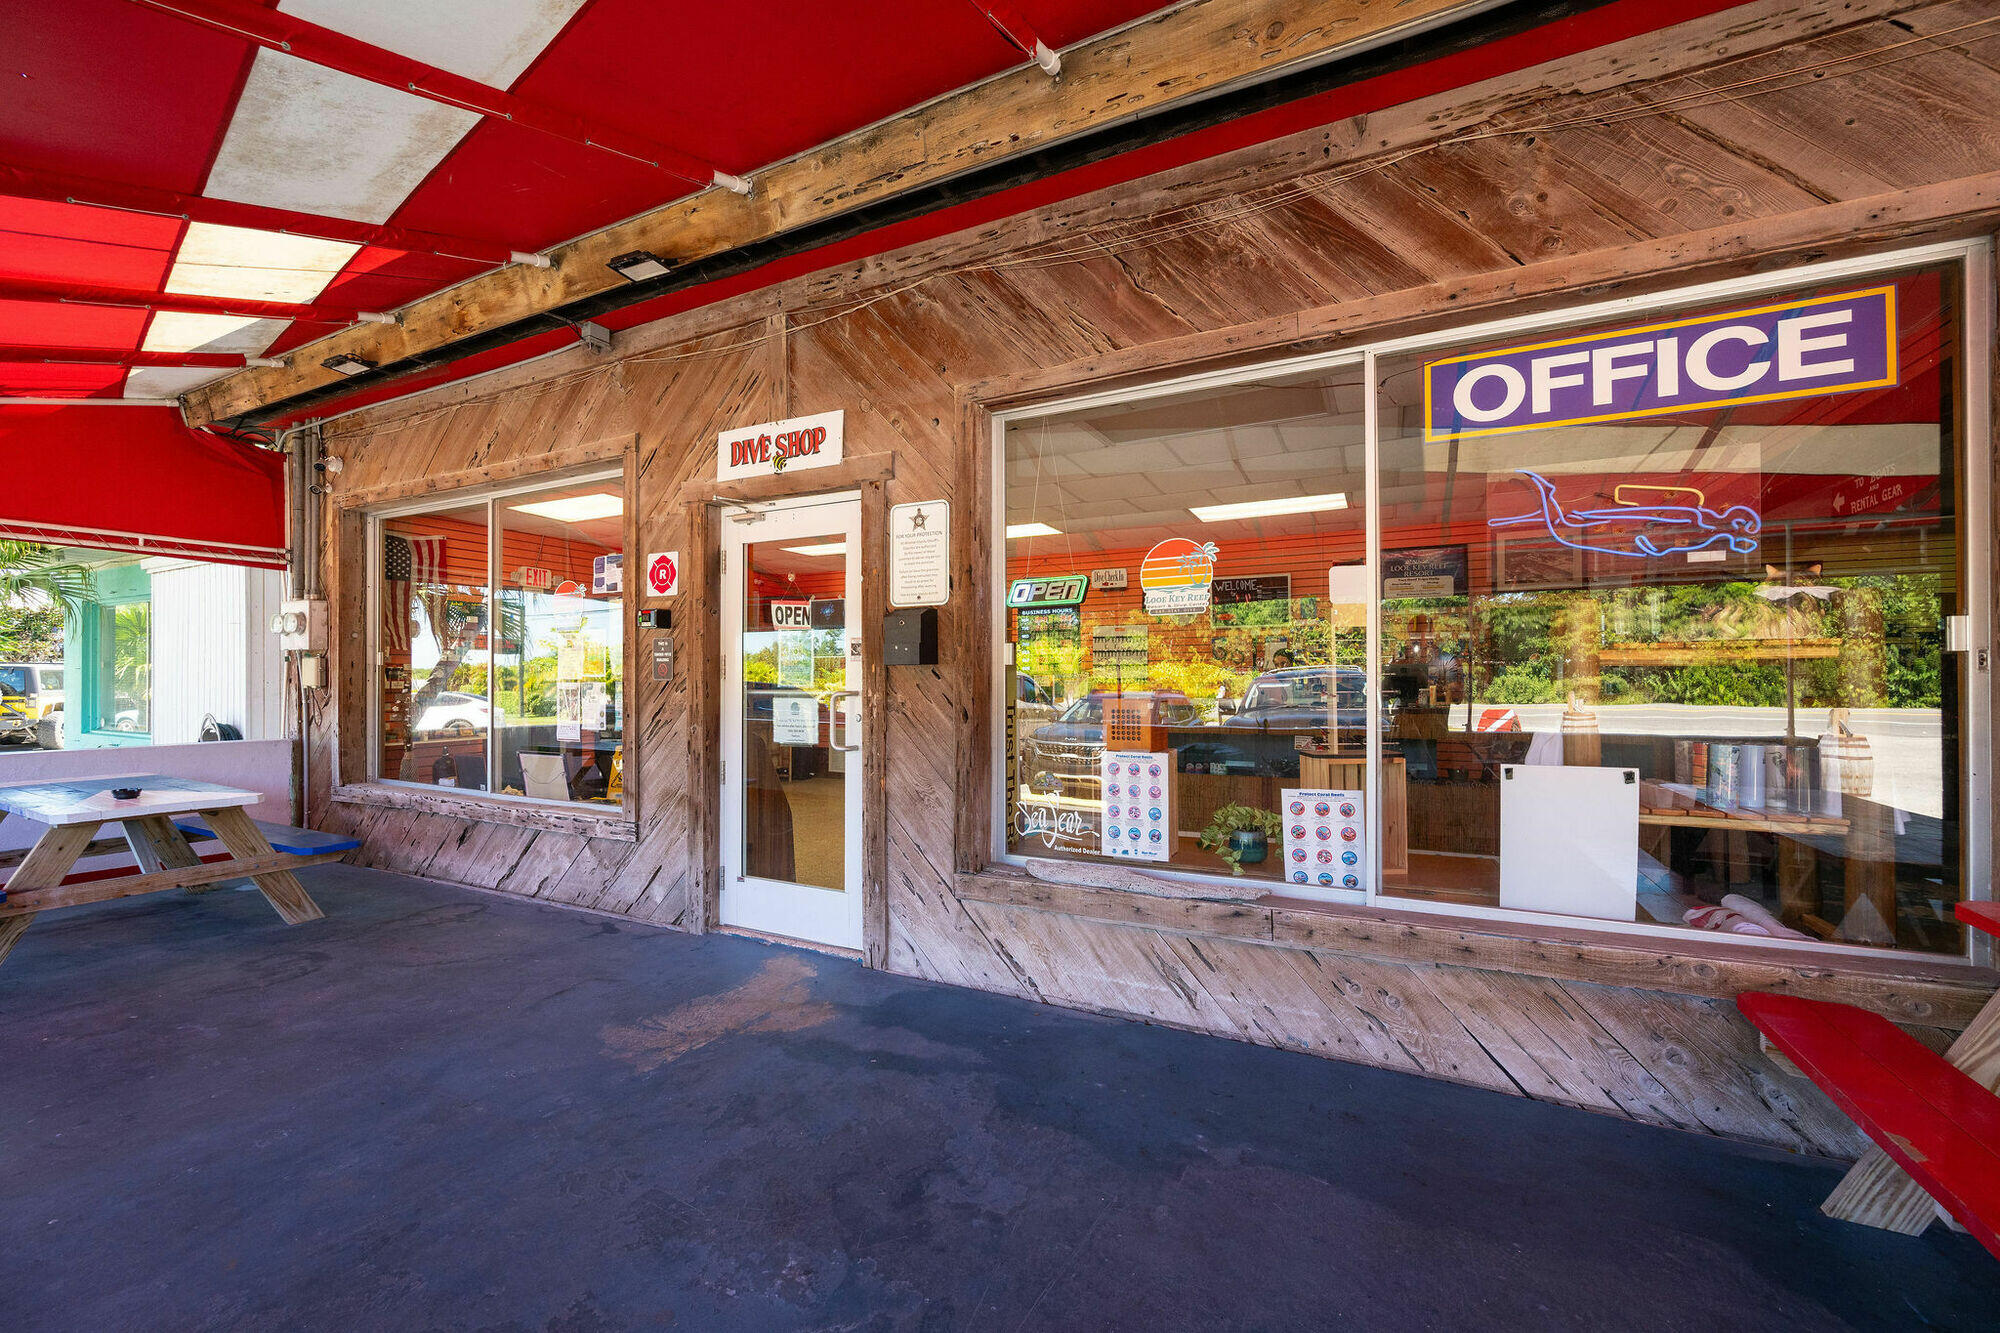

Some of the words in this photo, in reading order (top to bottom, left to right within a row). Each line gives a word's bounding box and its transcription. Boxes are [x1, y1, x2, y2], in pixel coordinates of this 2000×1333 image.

[1453, 309, 1854, 422] OFFICE
[730, 434, 772, 467] DIVE
[775, 426, 826, 460] SHOP
[1854, 477, 1864, 489] TO
[1869, 464, 1896, 484] BOATS
[1850, 494, 1879, 514] RENTAL
[1881, 484, 1903, 501] GEAR
[526, 568, 547, 587] EXIT
[659, 569, 667, 580] R
[1214, 579, 1258, 591] WELCOME
[1169, 594, 1186, 602] KEY
[775, 606, 810, 625] OPEN
[1007, 701, 1016, 764] Trust
[1054, 845, 1081, 853] Authorized
[1082, 847, 1101, 855] Dealer
